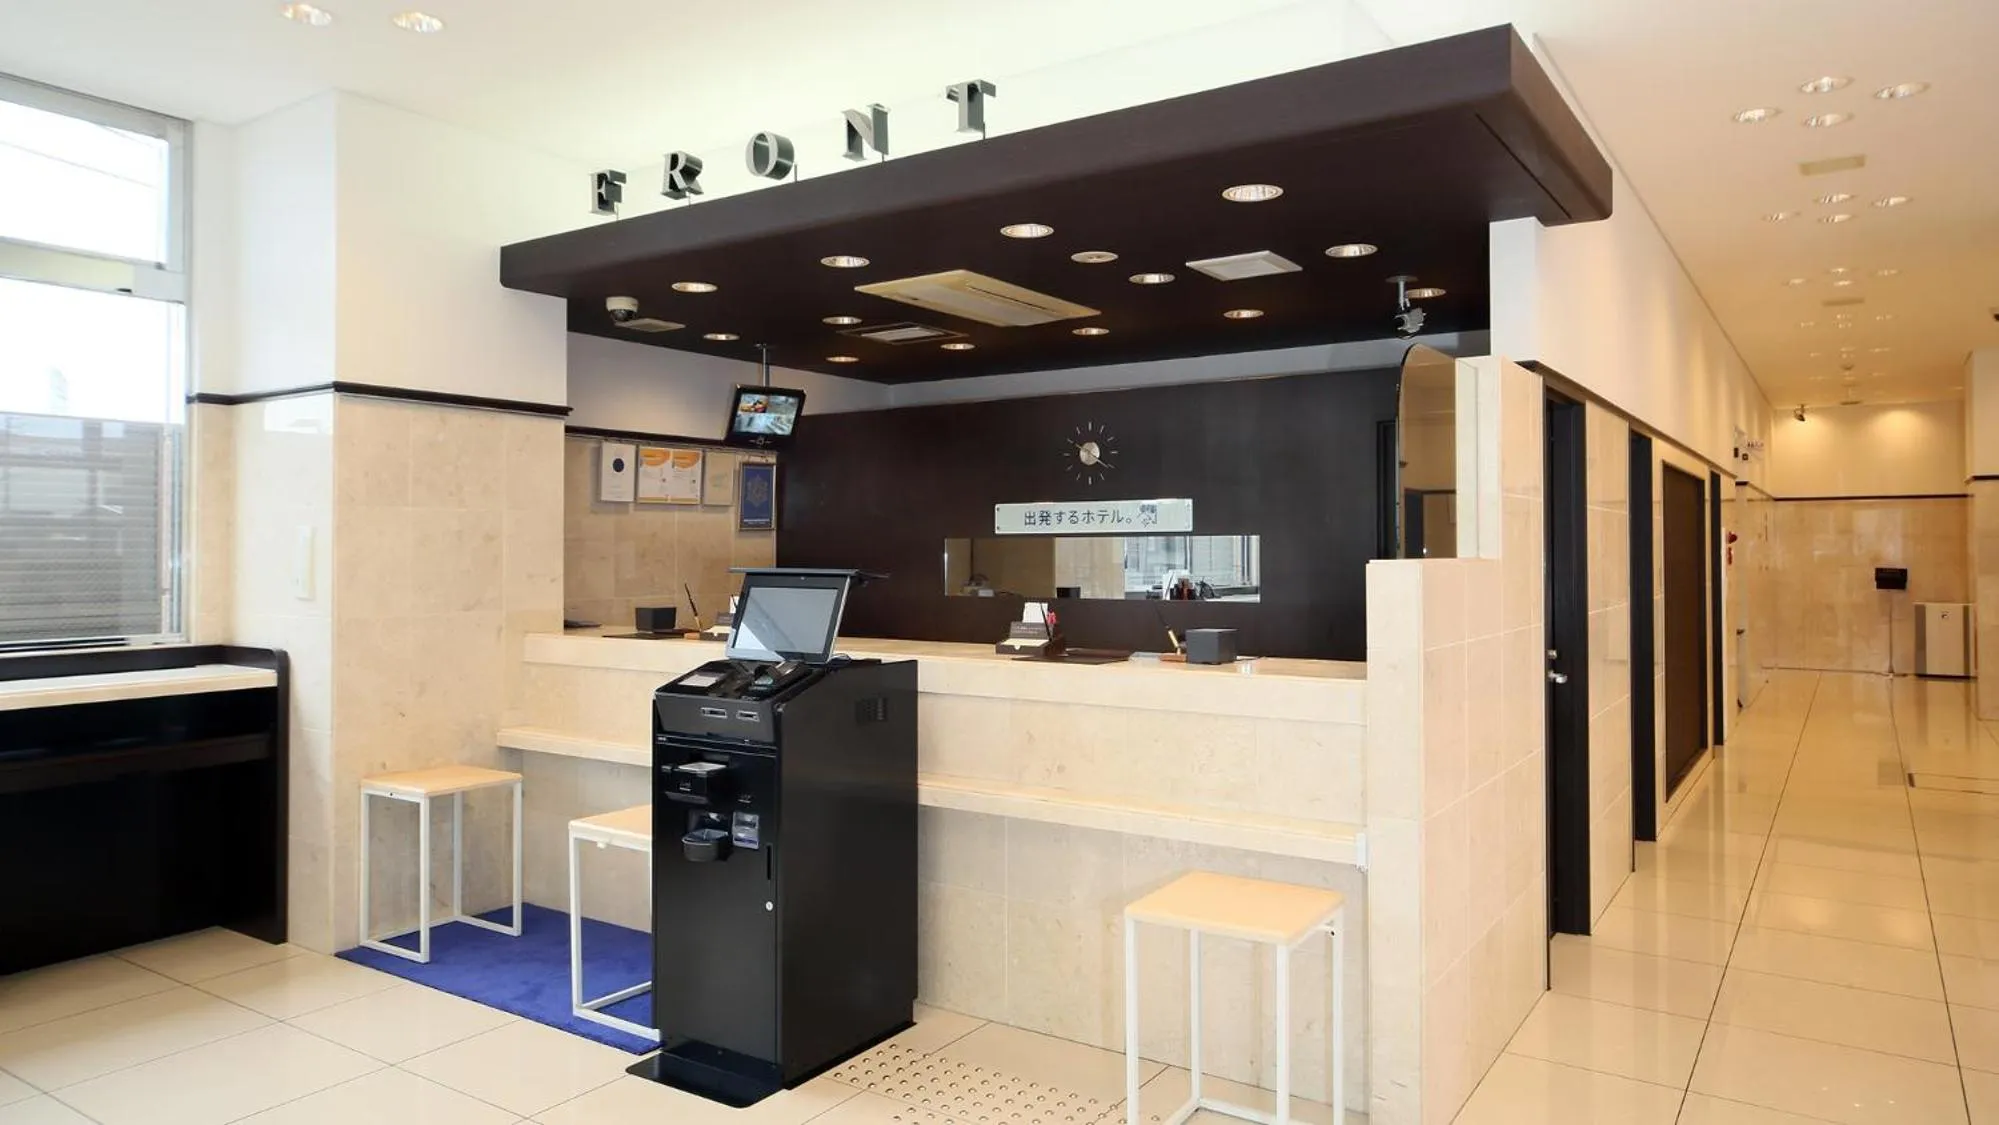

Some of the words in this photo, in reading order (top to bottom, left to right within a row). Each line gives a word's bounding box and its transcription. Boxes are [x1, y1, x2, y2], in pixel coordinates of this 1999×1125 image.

[589, 79, 996, 215] FRONT
[1024, 509, 1132, 526] 出発するホテル。
